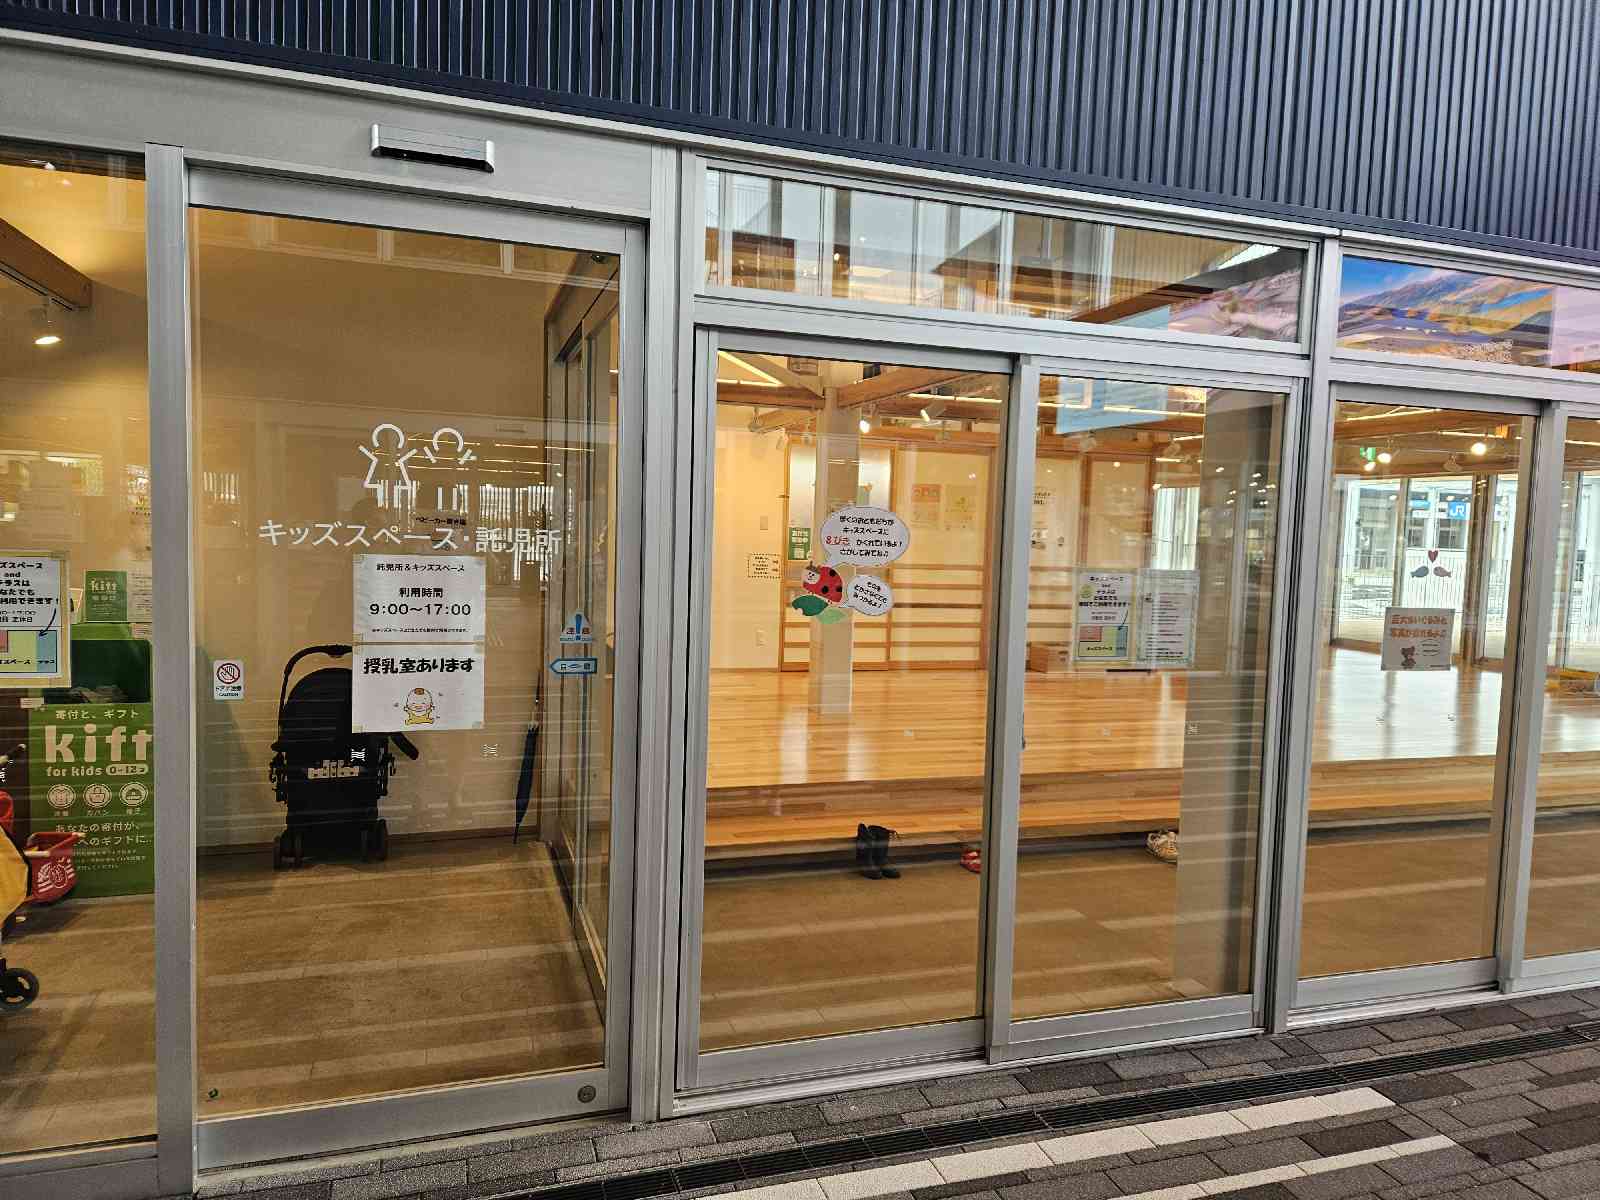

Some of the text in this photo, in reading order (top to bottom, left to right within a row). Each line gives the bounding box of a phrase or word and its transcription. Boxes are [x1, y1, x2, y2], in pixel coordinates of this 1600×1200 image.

[1450, 505, 1465, 516] JR
[399, 587, 444, 598] 利用時間
[363, 657, 475, 674] 授乳室あります
[44, 723, 153, 763] kift
[46, 766, 67, 777] for
[71, 765, 103, 776] kids
